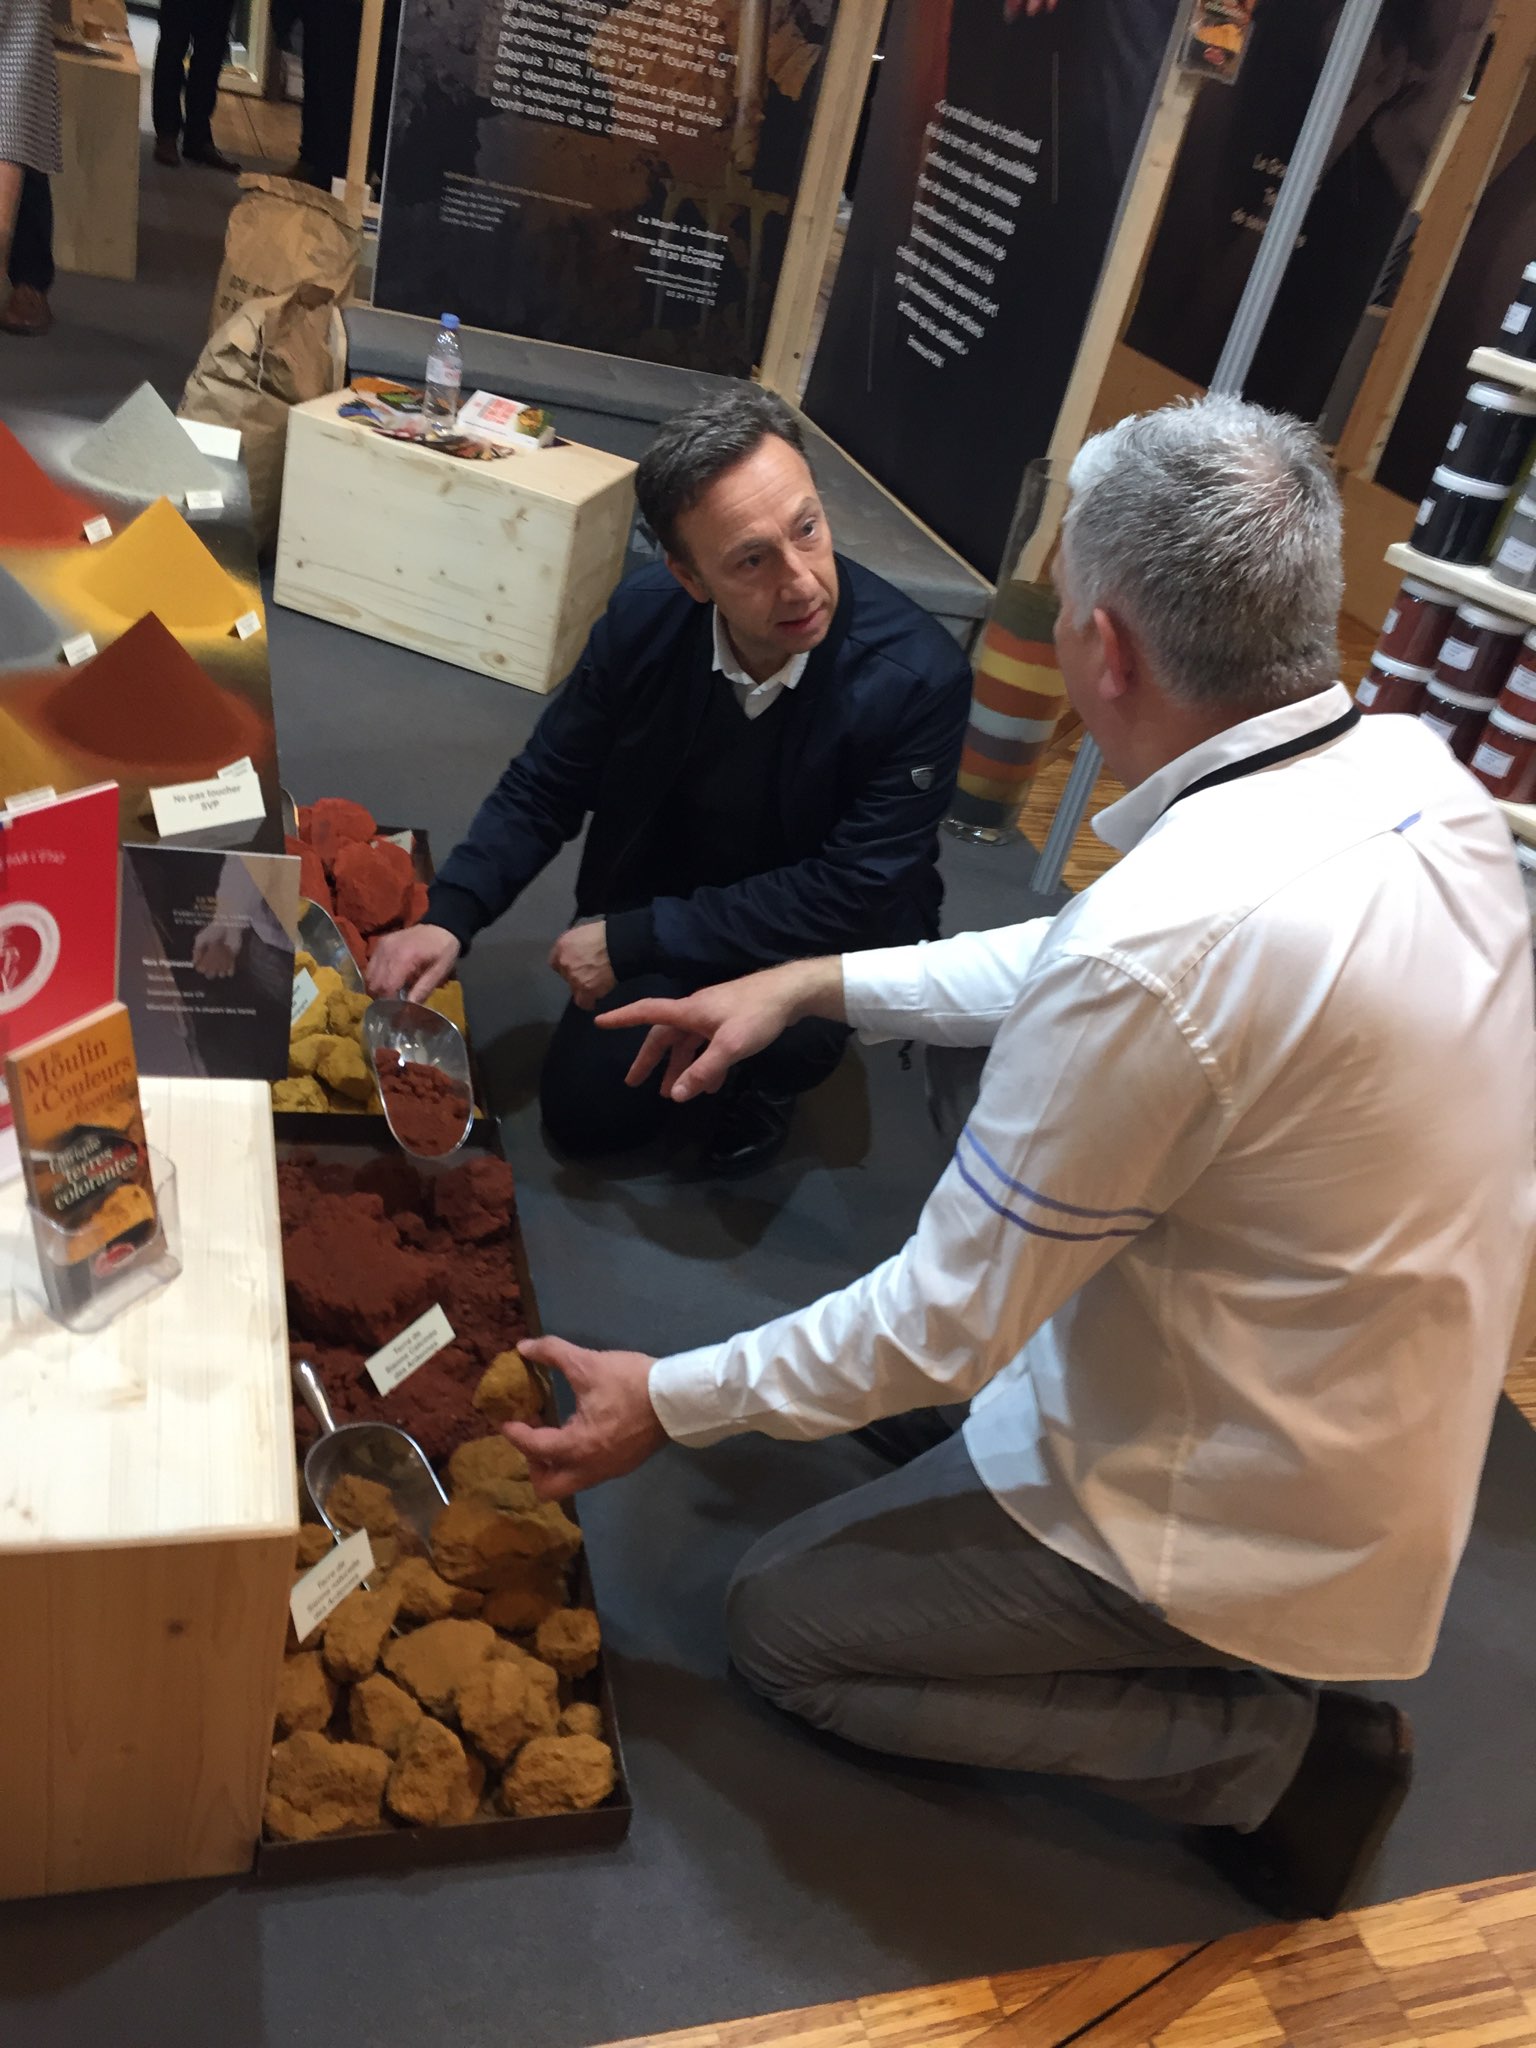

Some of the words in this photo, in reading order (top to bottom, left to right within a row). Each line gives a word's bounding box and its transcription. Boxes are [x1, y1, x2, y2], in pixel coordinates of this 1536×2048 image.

[503, 0, 560, 20] grandes
[561, 12, 619, 35] marques
[621, 25, 639, 40] de
[640, 32, 695, 54] peinture
[697, 43, 716, 60] les
[609, 7, 700, 38] restaurateurs.
[702, 28, 726, 45] Les
[663, 2, 682, 16] de
[499, 31, 597, 64] professionnels
[599, 54, 616, 69] de
[501, 11, 572, 41] également
[628, 46, 660, 62] pour
[662, 52, 706, 73] fournir
[708, 63, 727, 79] les
[495, 62, 521, 79] des
[522, 69, 591, 96] demandes
[591, 87, 676, 117] extrêmement
[678, 108, 723, 129] variées
[498, 44, 544, 68] Depuis
[585, 66, 659, 95] l'entreprise
[660, 87, 707, 108] répond
[708, 97, 717, 110] à
[490, 96, 566, 123] contraintes
[567, 113, 586, 128] de
[586, 118, 604, 132] sa
[604, 122, 660, 145] clientèle.
[492, 80, 511, 94] en
[512, 83, 583, 111] s'adaptant
[584, 102, 609, 117] aux
[609, 106, 659, 129] besoins
[660, 120, 674, 133] et
[676, 124, 700, 138] aux
[637, 214, 650, 225] Le
[650, 217, 681, 232] Moulin
[689, 226, 729, 243] Couleurs
[206, 784, 242, 798] toucher
[24, 1038, 109, 1094] Moulin
[41, 1055, 133, 1113] Couleurs
[54, 1153, 139, 1212] colorantes
[65, 1148, 114, 1186] terres
